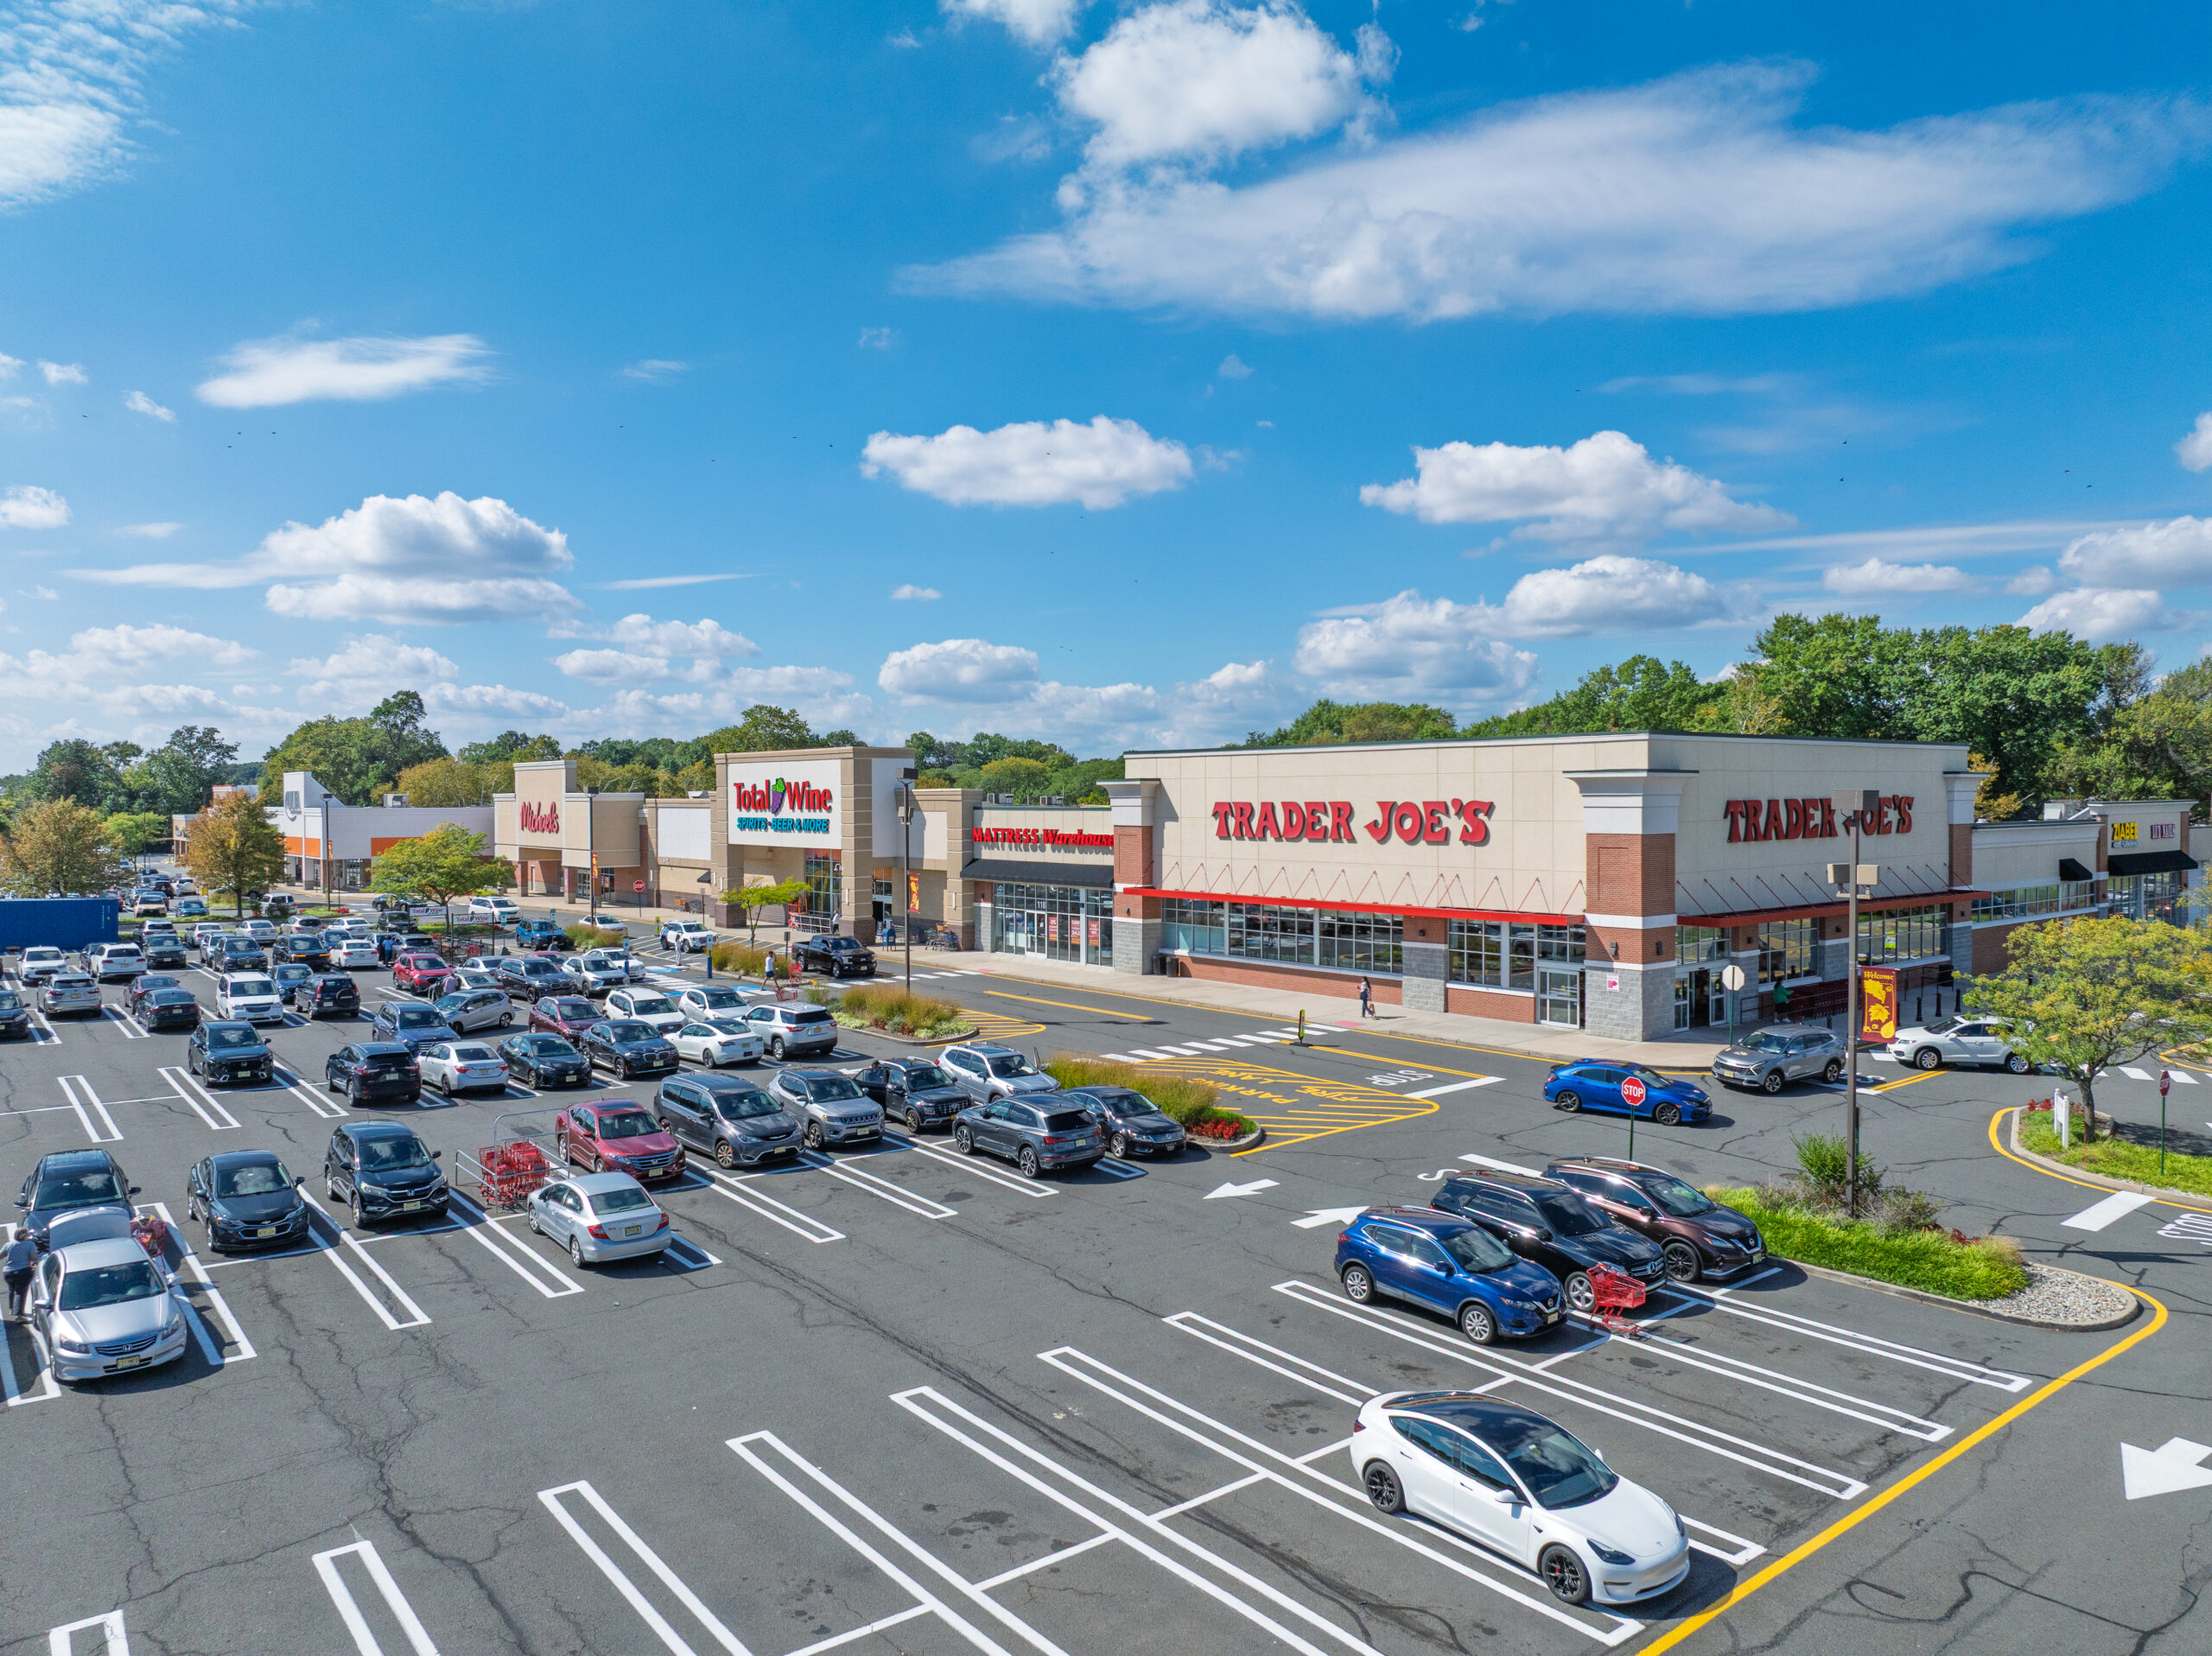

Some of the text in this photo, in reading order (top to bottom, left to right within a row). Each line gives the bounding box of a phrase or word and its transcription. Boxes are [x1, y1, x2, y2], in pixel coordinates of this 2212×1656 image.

[734, 779, 833, 811] Total Wine
[520, 802, 559, 832] Michaels
[737, 817, 829, 831] SPIRITS BEER & MORE
[1212, 797, 1494, 843] TRADER JOE'S
[1724, 794, 1915, 842] TRADER OE'S
[972, 828, 1115, 847] MATTRESS Warehouse
[1863, 971, 1894, 980] Welcome
[1185, 1077, 1300, 1104] PARKING
[1208, 1068, 1359, 1102] FIRE LANE
[1365, 1069, 1434, 1086] STOP
[1623, 1084, 1643, 1098] STOP
